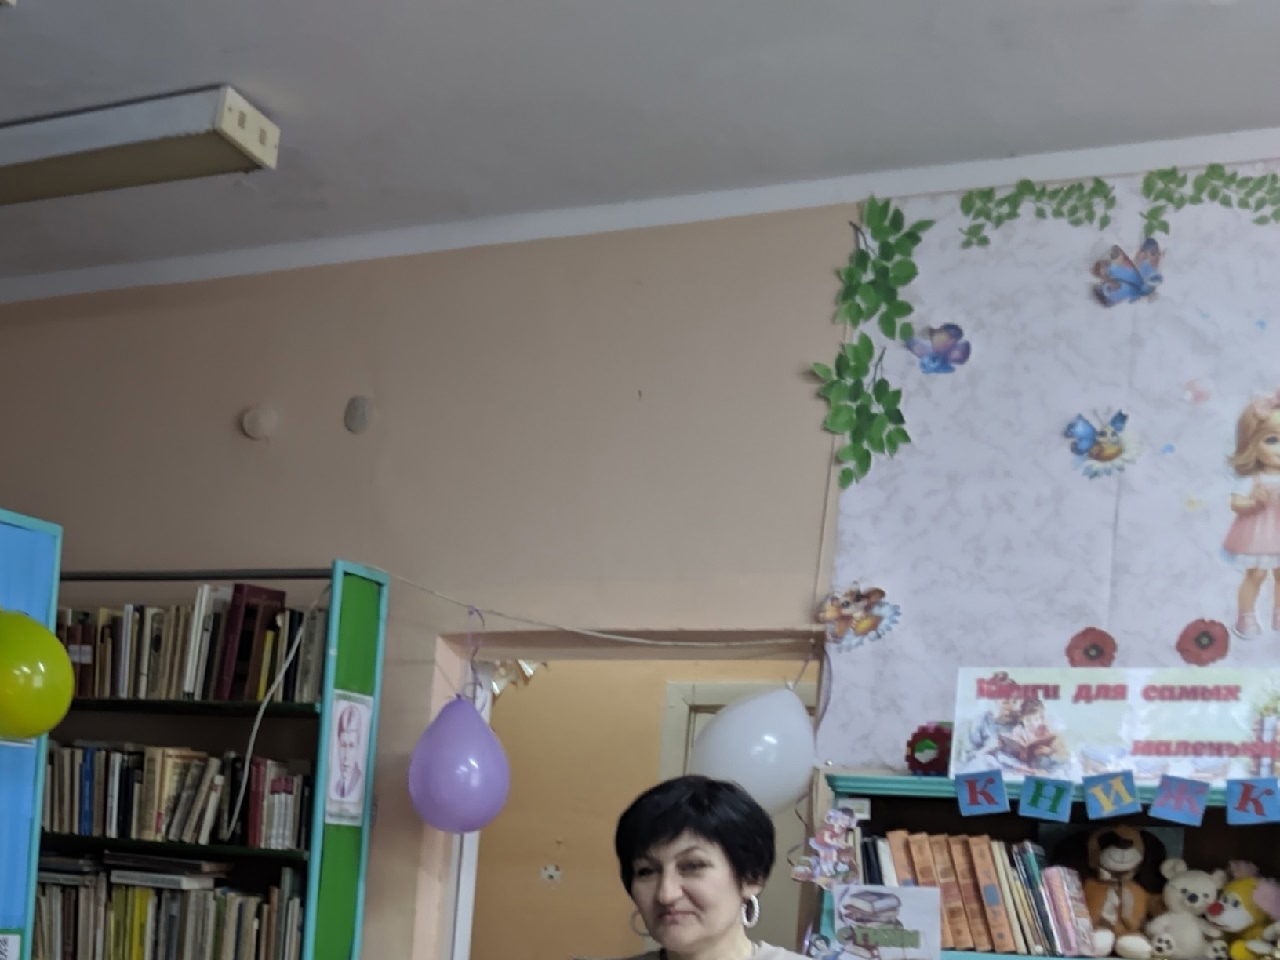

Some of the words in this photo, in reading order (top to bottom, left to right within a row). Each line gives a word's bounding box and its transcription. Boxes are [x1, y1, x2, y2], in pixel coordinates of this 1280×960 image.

[976, 678, 1060, 701] Книги
[1072, 684, 1128, 704] для
[1141, 684, 1241, 702] самых
